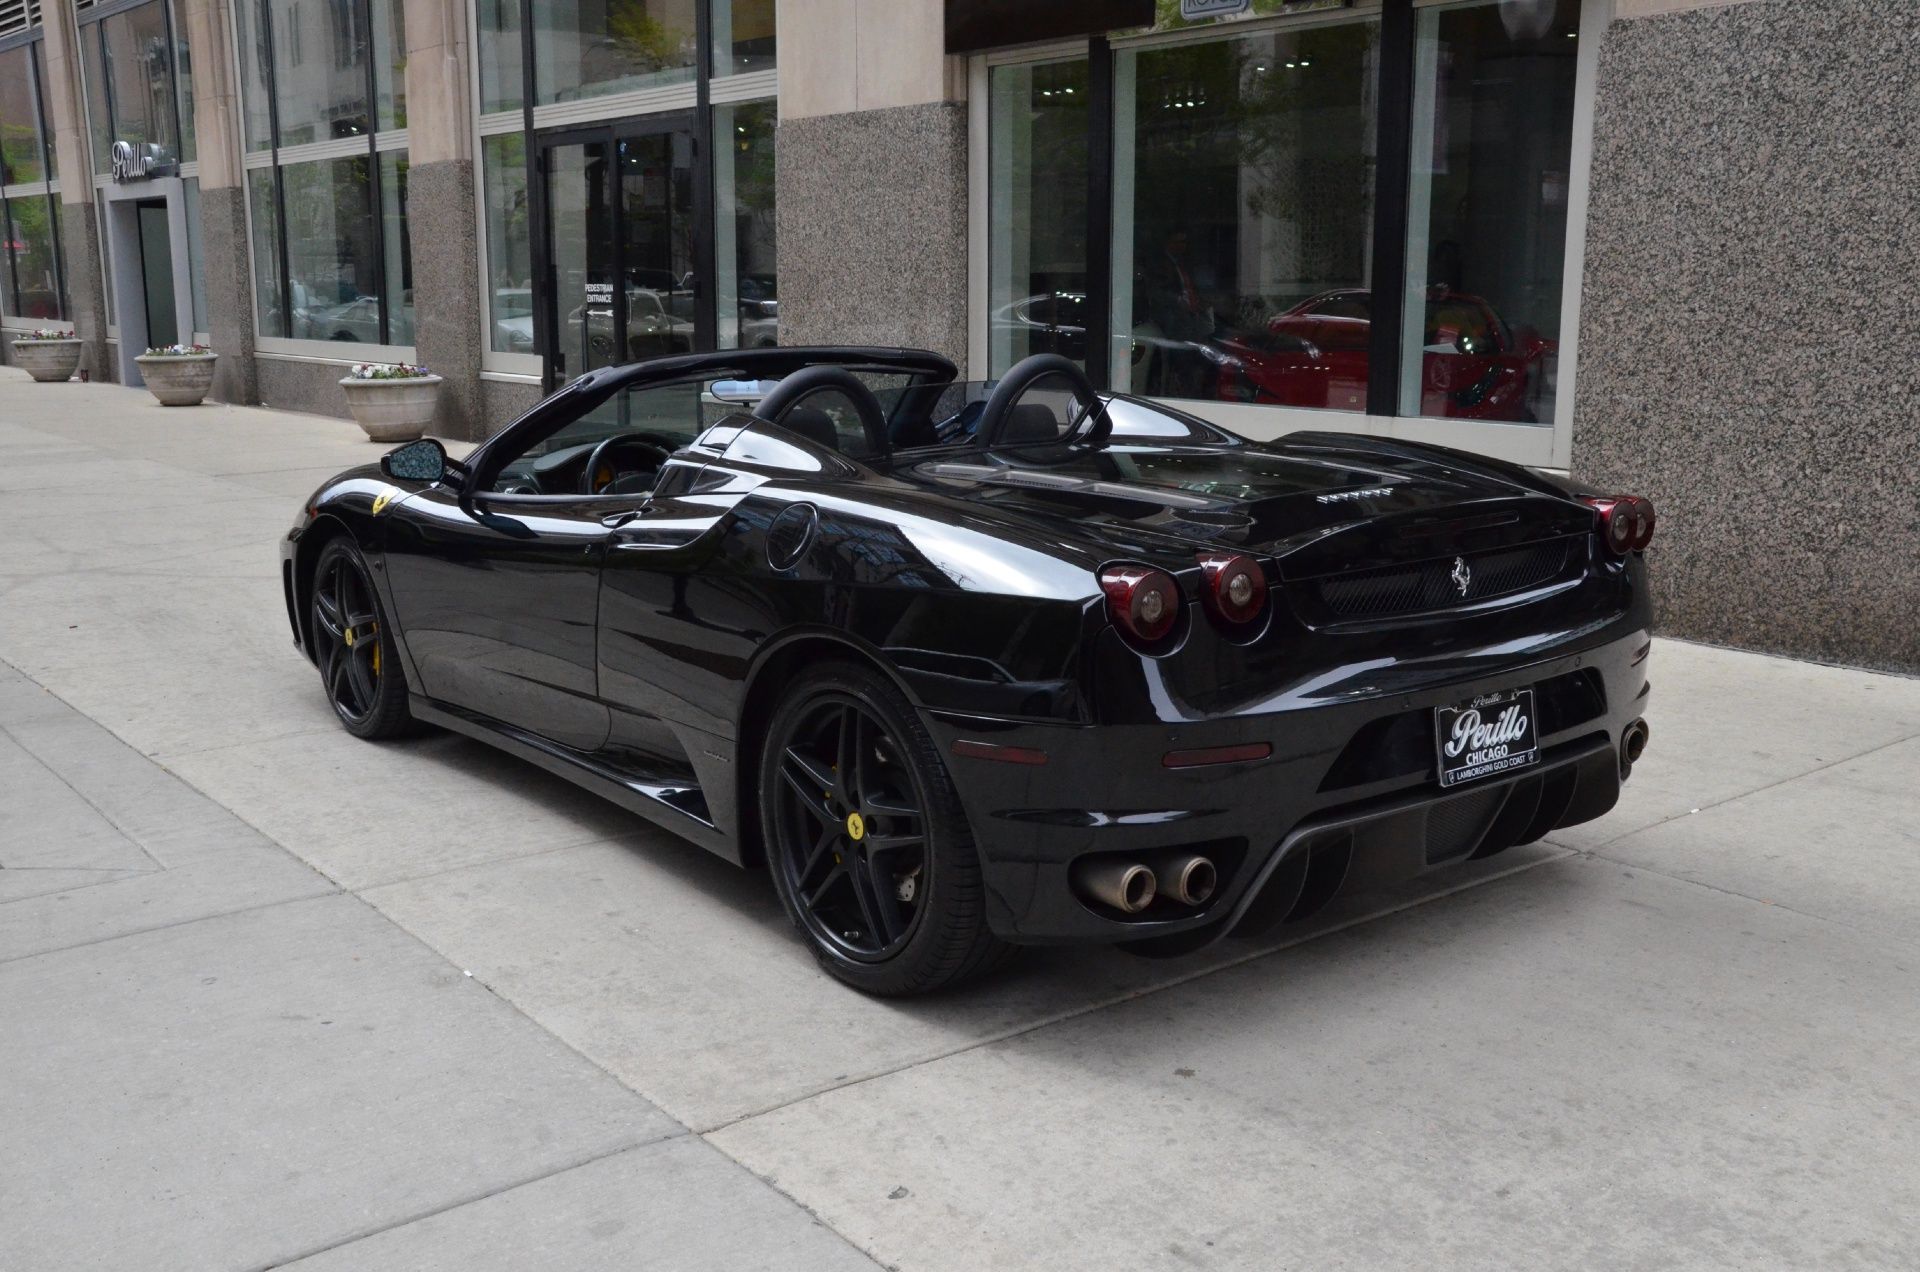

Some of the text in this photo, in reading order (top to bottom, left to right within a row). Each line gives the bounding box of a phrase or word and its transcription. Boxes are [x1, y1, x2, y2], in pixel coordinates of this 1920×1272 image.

[112, 141, 147, 180] Perillo
[585, 284, 613, 292] PEDESTRIAN
[587, 294, 612, 303] ENTRANCE
[1470, 692, 1502, 708] Perillo
[1444, 704, 1528, 758] Perillo
[1466, 744, 1508, 767] CHICAGO
[1456, 755, 1526, 781] LAMBORGHINI GOLD COAST
